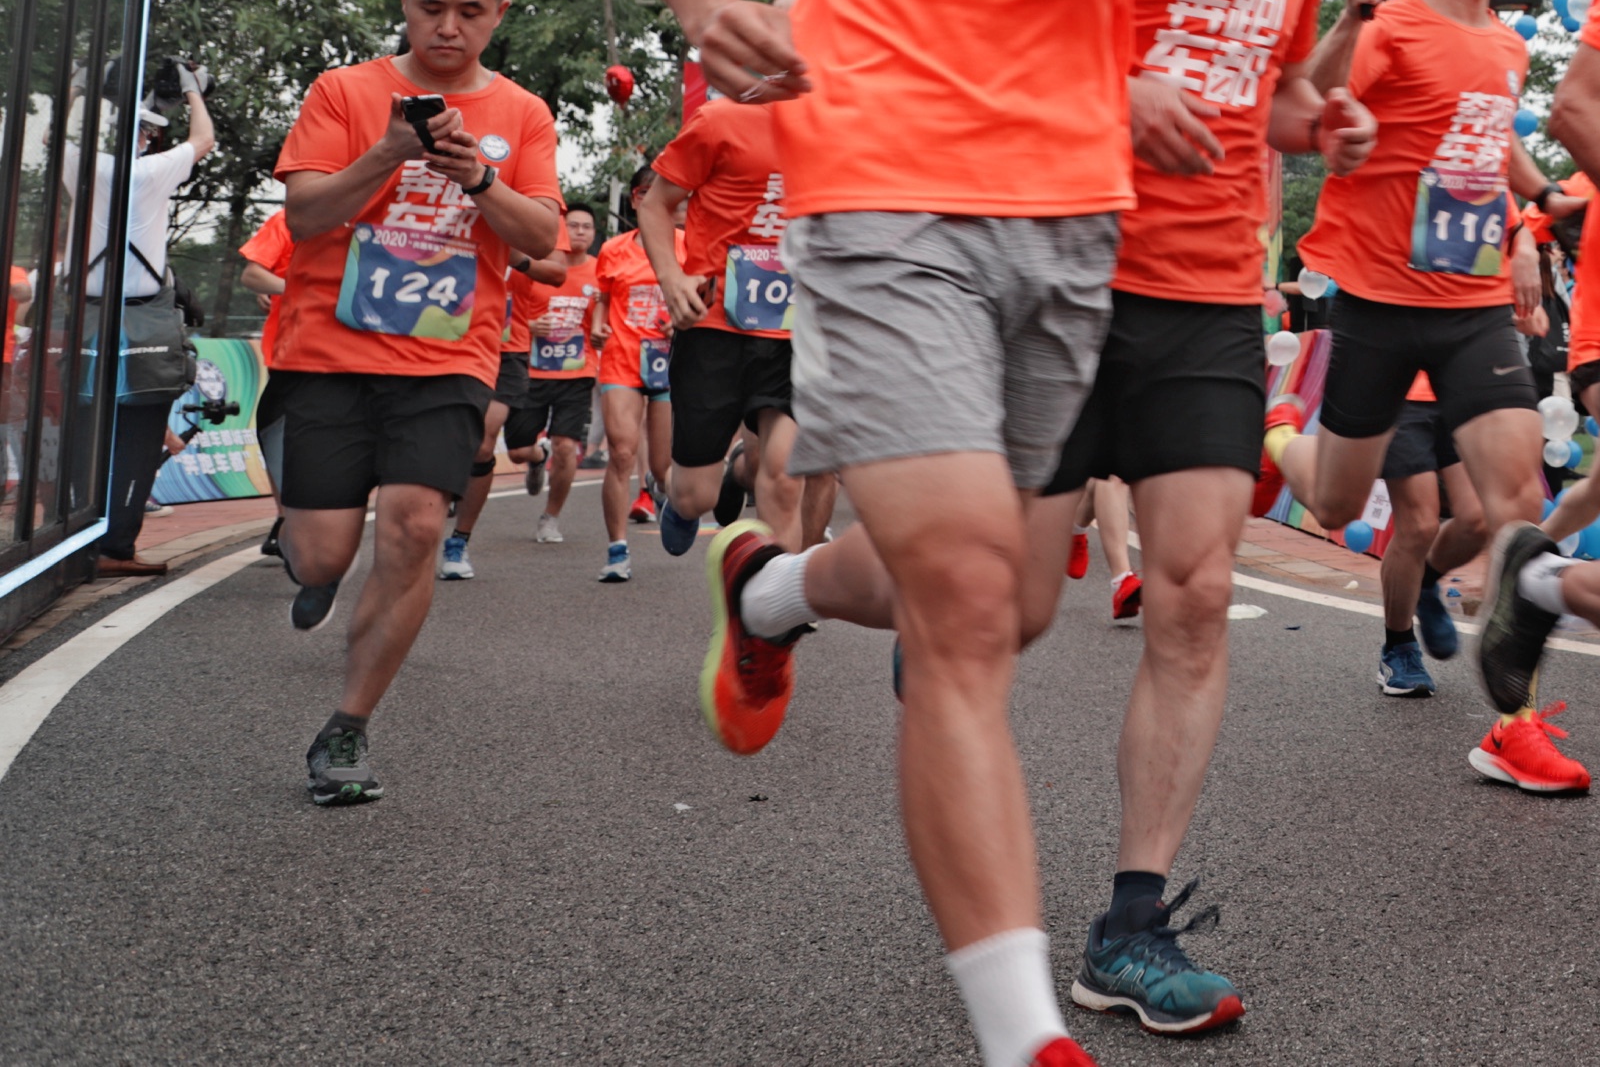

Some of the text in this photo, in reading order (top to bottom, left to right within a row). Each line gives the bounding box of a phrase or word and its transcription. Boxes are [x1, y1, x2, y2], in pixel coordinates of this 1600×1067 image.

[1142, 28, 1274, 107] 车都
[372, 229, 408, 248] 2020
[1432, 210, 1503, 244] 116
[743, 249, 769, 261] 2020
[369, 267, 458, 307] 124
[540, 344, 578, 358] 053
